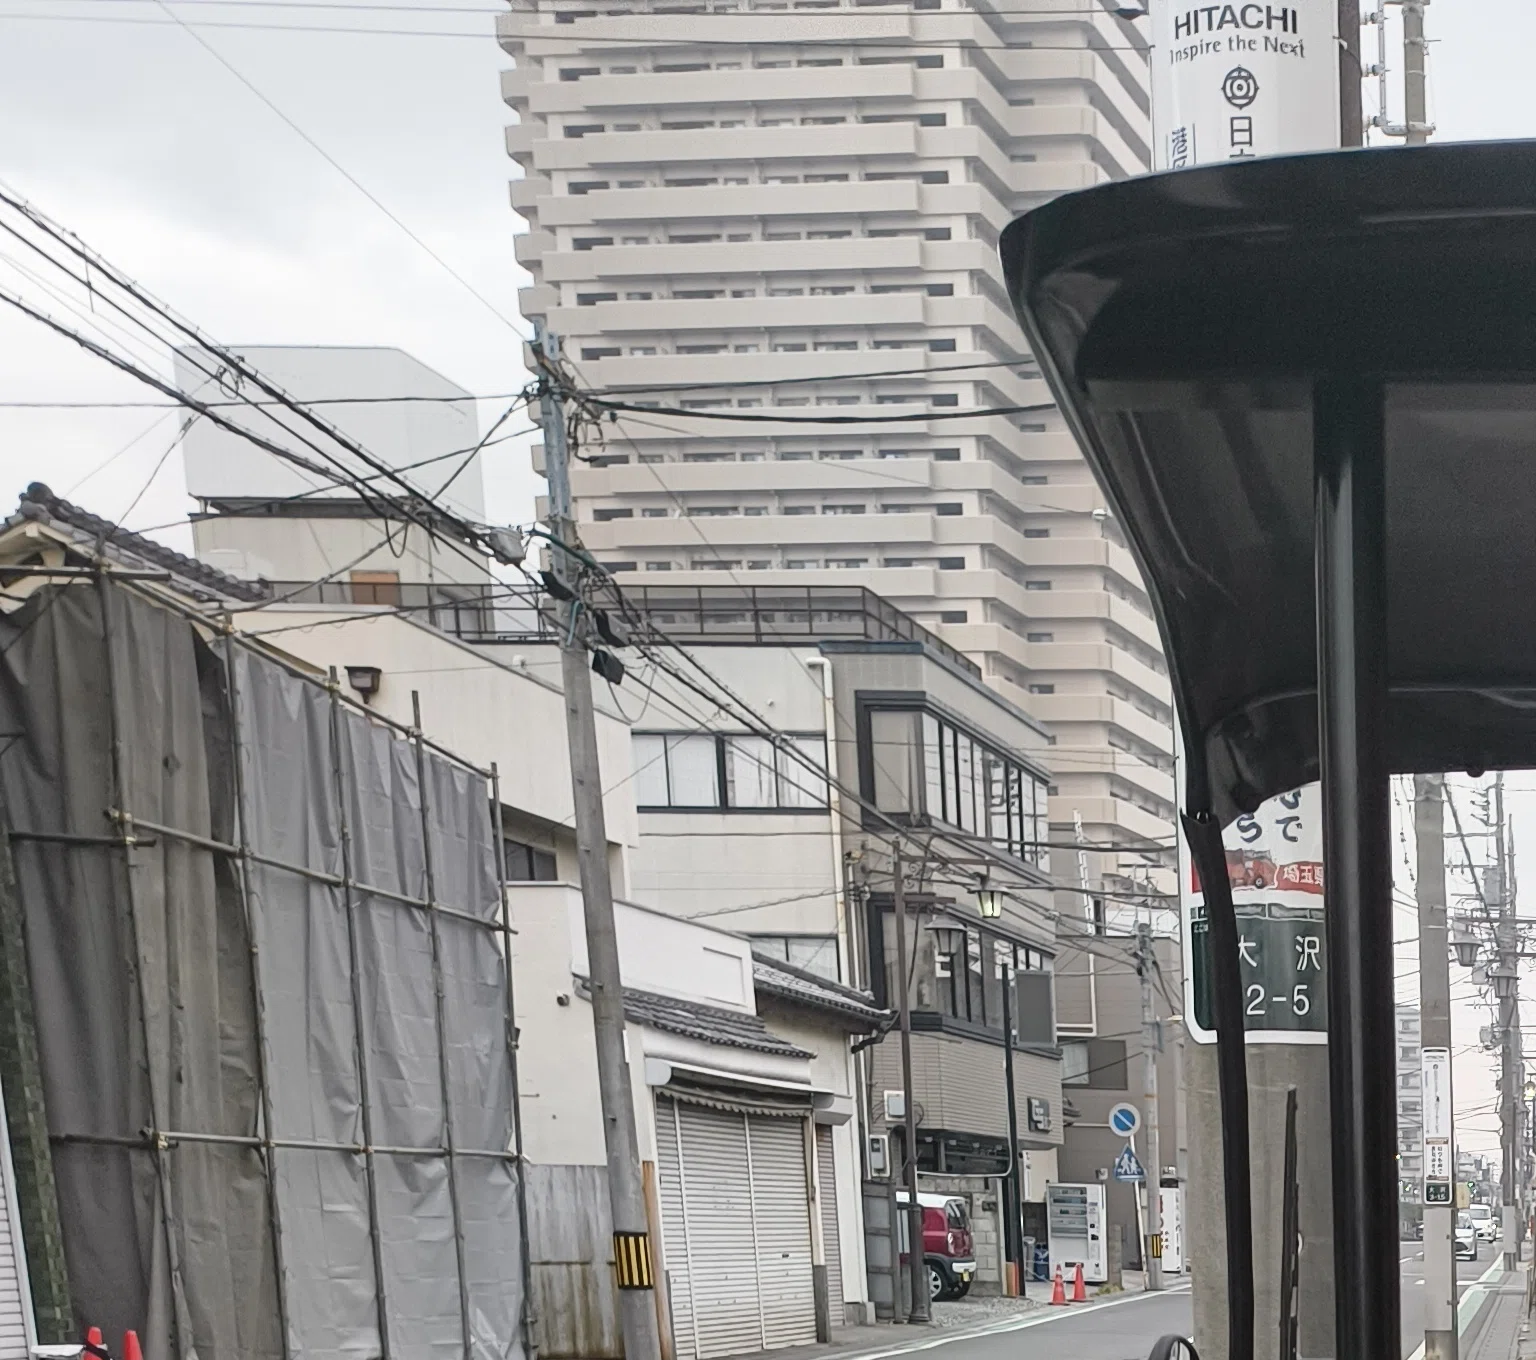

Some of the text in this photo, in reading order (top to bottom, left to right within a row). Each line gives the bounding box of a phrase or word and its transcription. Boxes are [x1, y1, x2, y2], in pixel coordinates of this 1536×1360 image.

[1174, 3, 1298, 40] HITACHI
[1170, 34, 1306, 65] Inspire the Next
[1246, 983, 1310, 1016] 2-5
